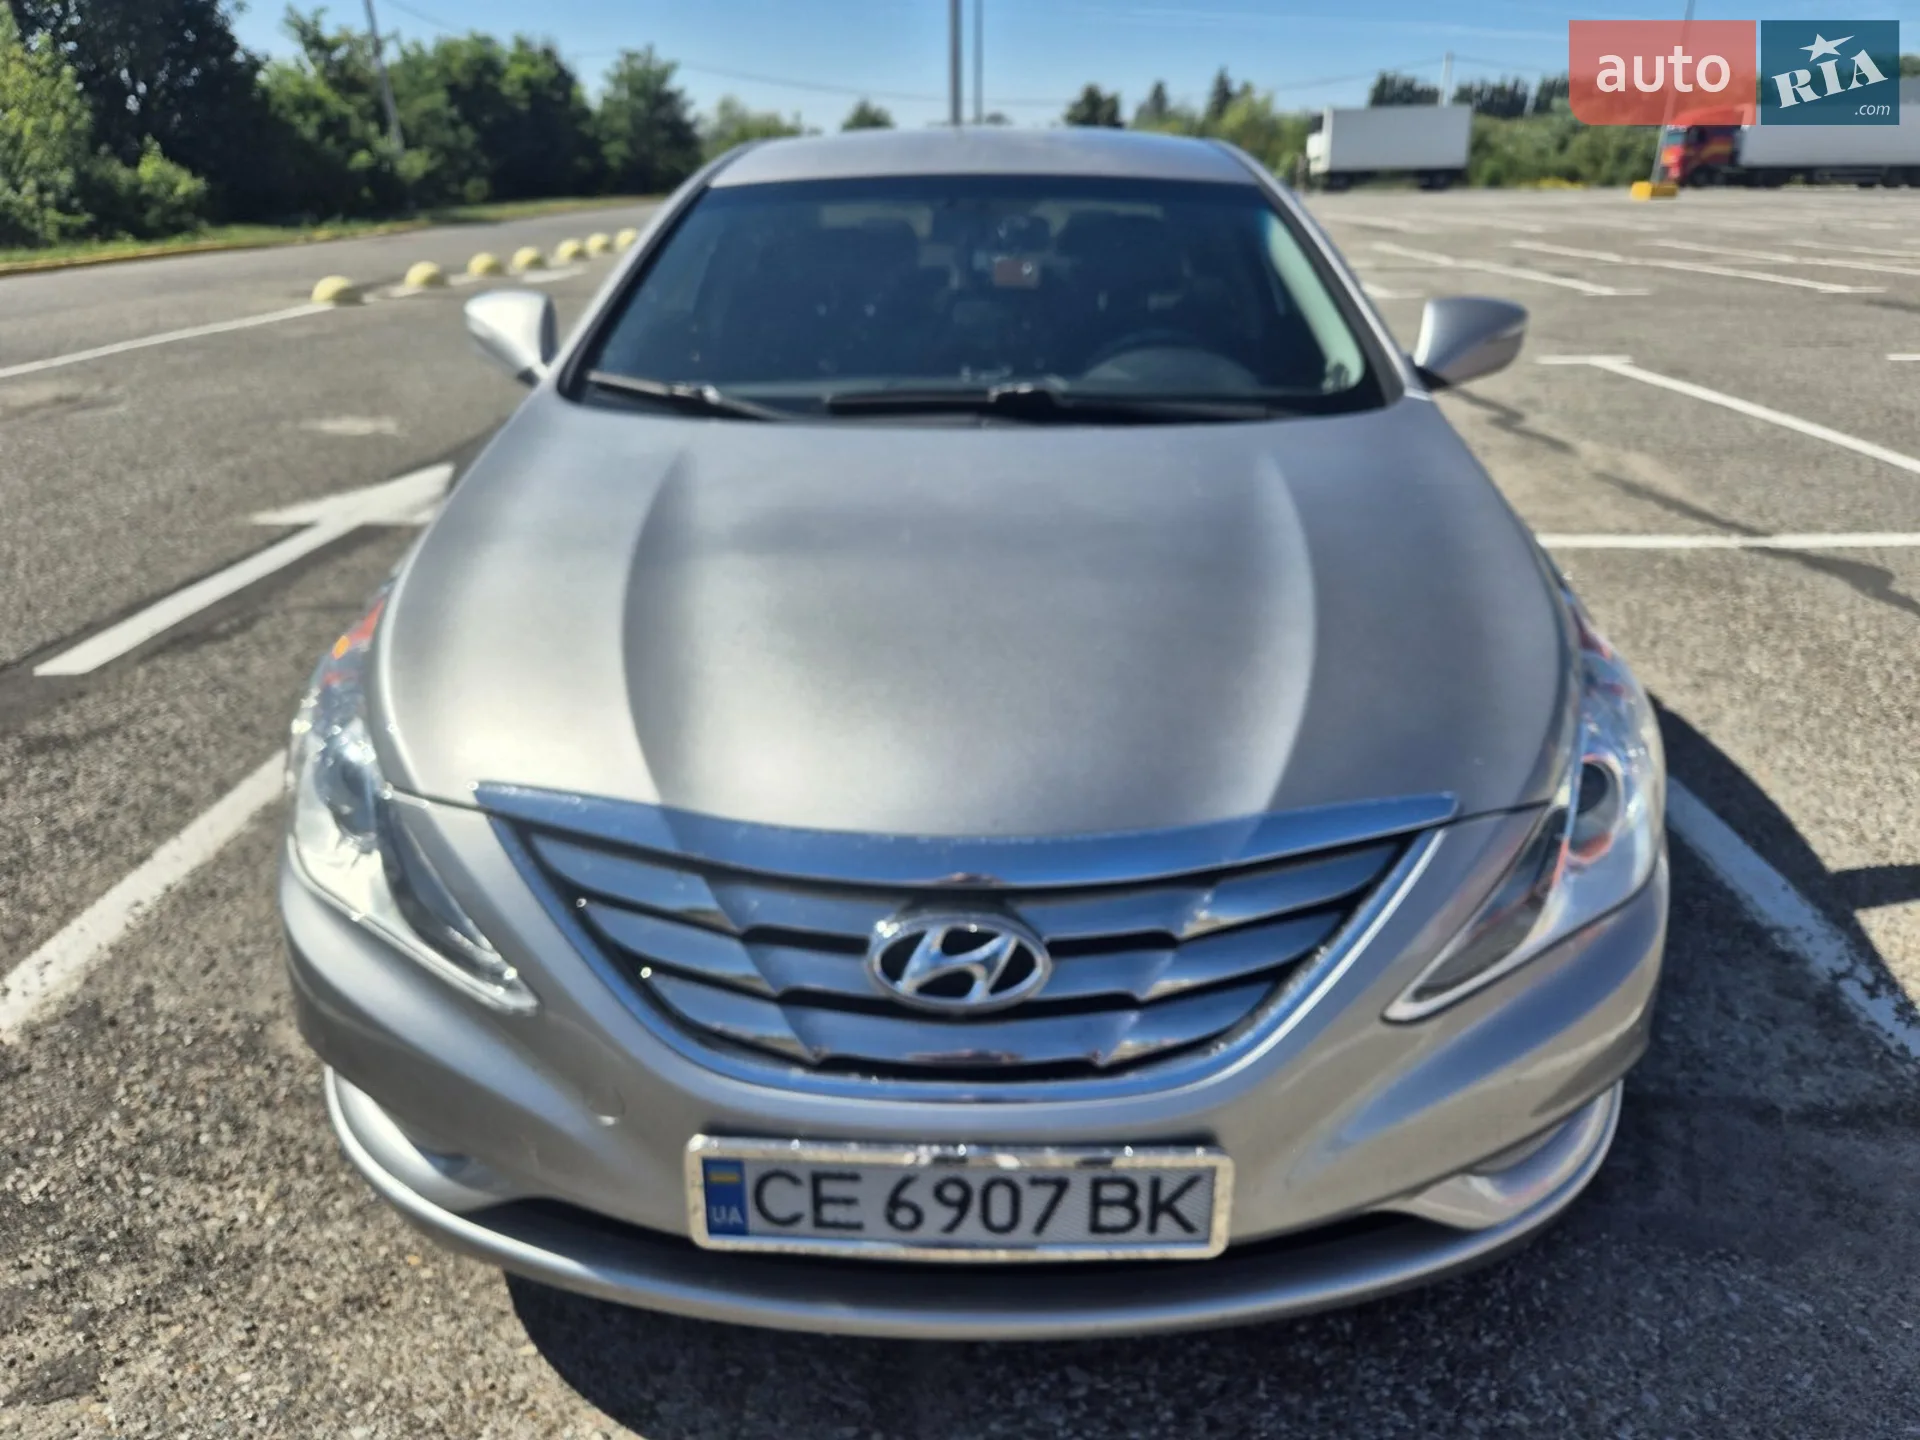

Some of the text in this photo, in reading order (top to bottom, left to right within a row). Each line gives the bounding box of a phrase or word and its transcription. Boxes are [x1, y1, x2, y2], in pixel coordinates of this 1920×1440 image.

[711, 1204, 744, 1226] UA
[752, 1169, 1199, 1236] CE 6907 BK
